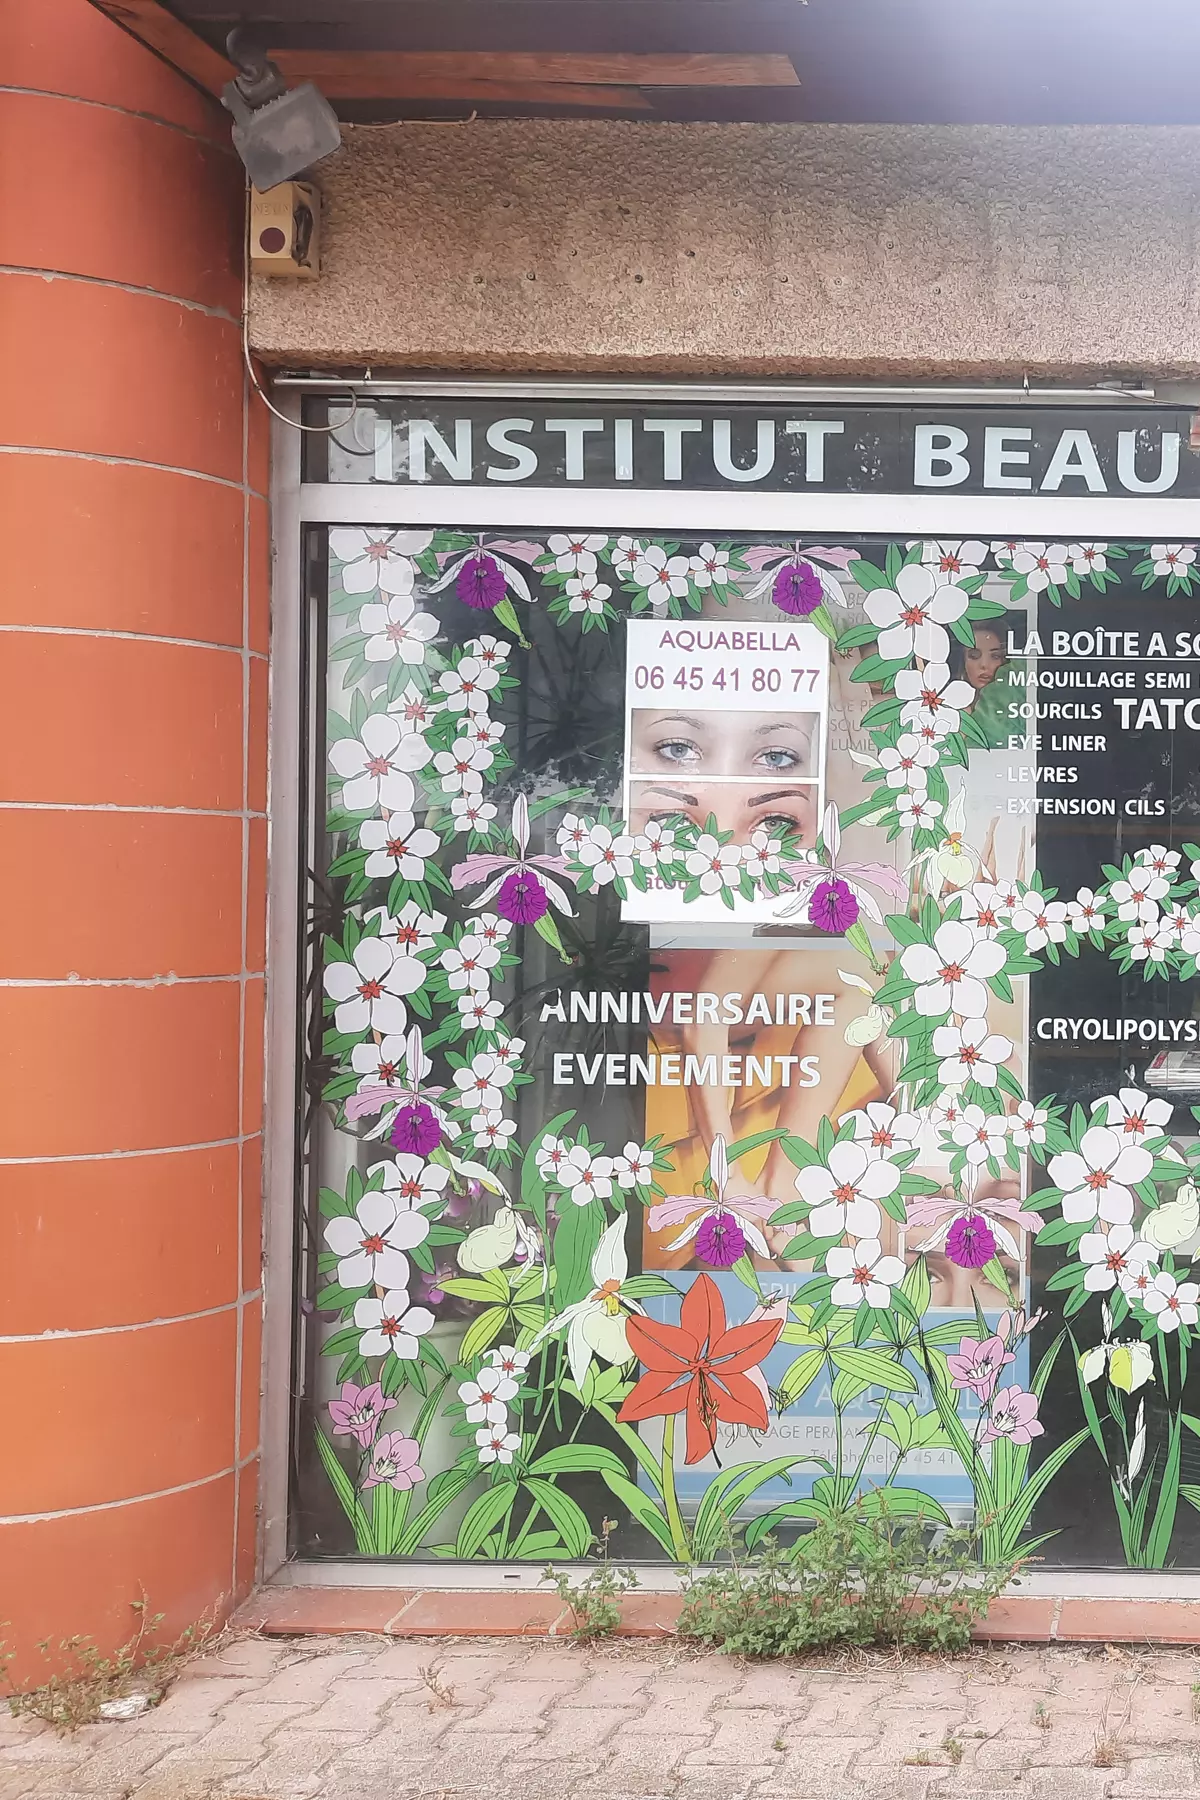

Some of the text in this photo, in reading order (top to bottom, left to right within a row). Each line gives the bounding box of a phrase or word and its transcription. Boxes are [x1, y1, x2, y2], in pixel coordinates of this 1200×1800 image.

[373, 418, 845, 483] INSTITUT
[659, 630, 801, 652] AQUABELLA
[1006, 630, 1044, 655] LA
[1052, 626, 1140, 657] BOÎTE
[1146, 632, 1168, 657] A
[634, 665, 820, 693] 06 45 41 80 77
[1008, 671, 1135, 690] MAQUILLAGE
[1144, 672, 1191, 689] SEMI
[1007, 702, 1102, 721] SOURCILS
[1007, 734, 1043, 751] EYE
[1051, 735, 1107, 752] LINER
[1007, 766, 1078, 783] LEVRES
[1006, 798, 1116, 816] EXTENSION
[1124, 799, 1166, 817] CILS
[539, 988, 836, 1026] ANNIVERSAIRE
[552, 1053, 821, 1088] EVENEMENTS
